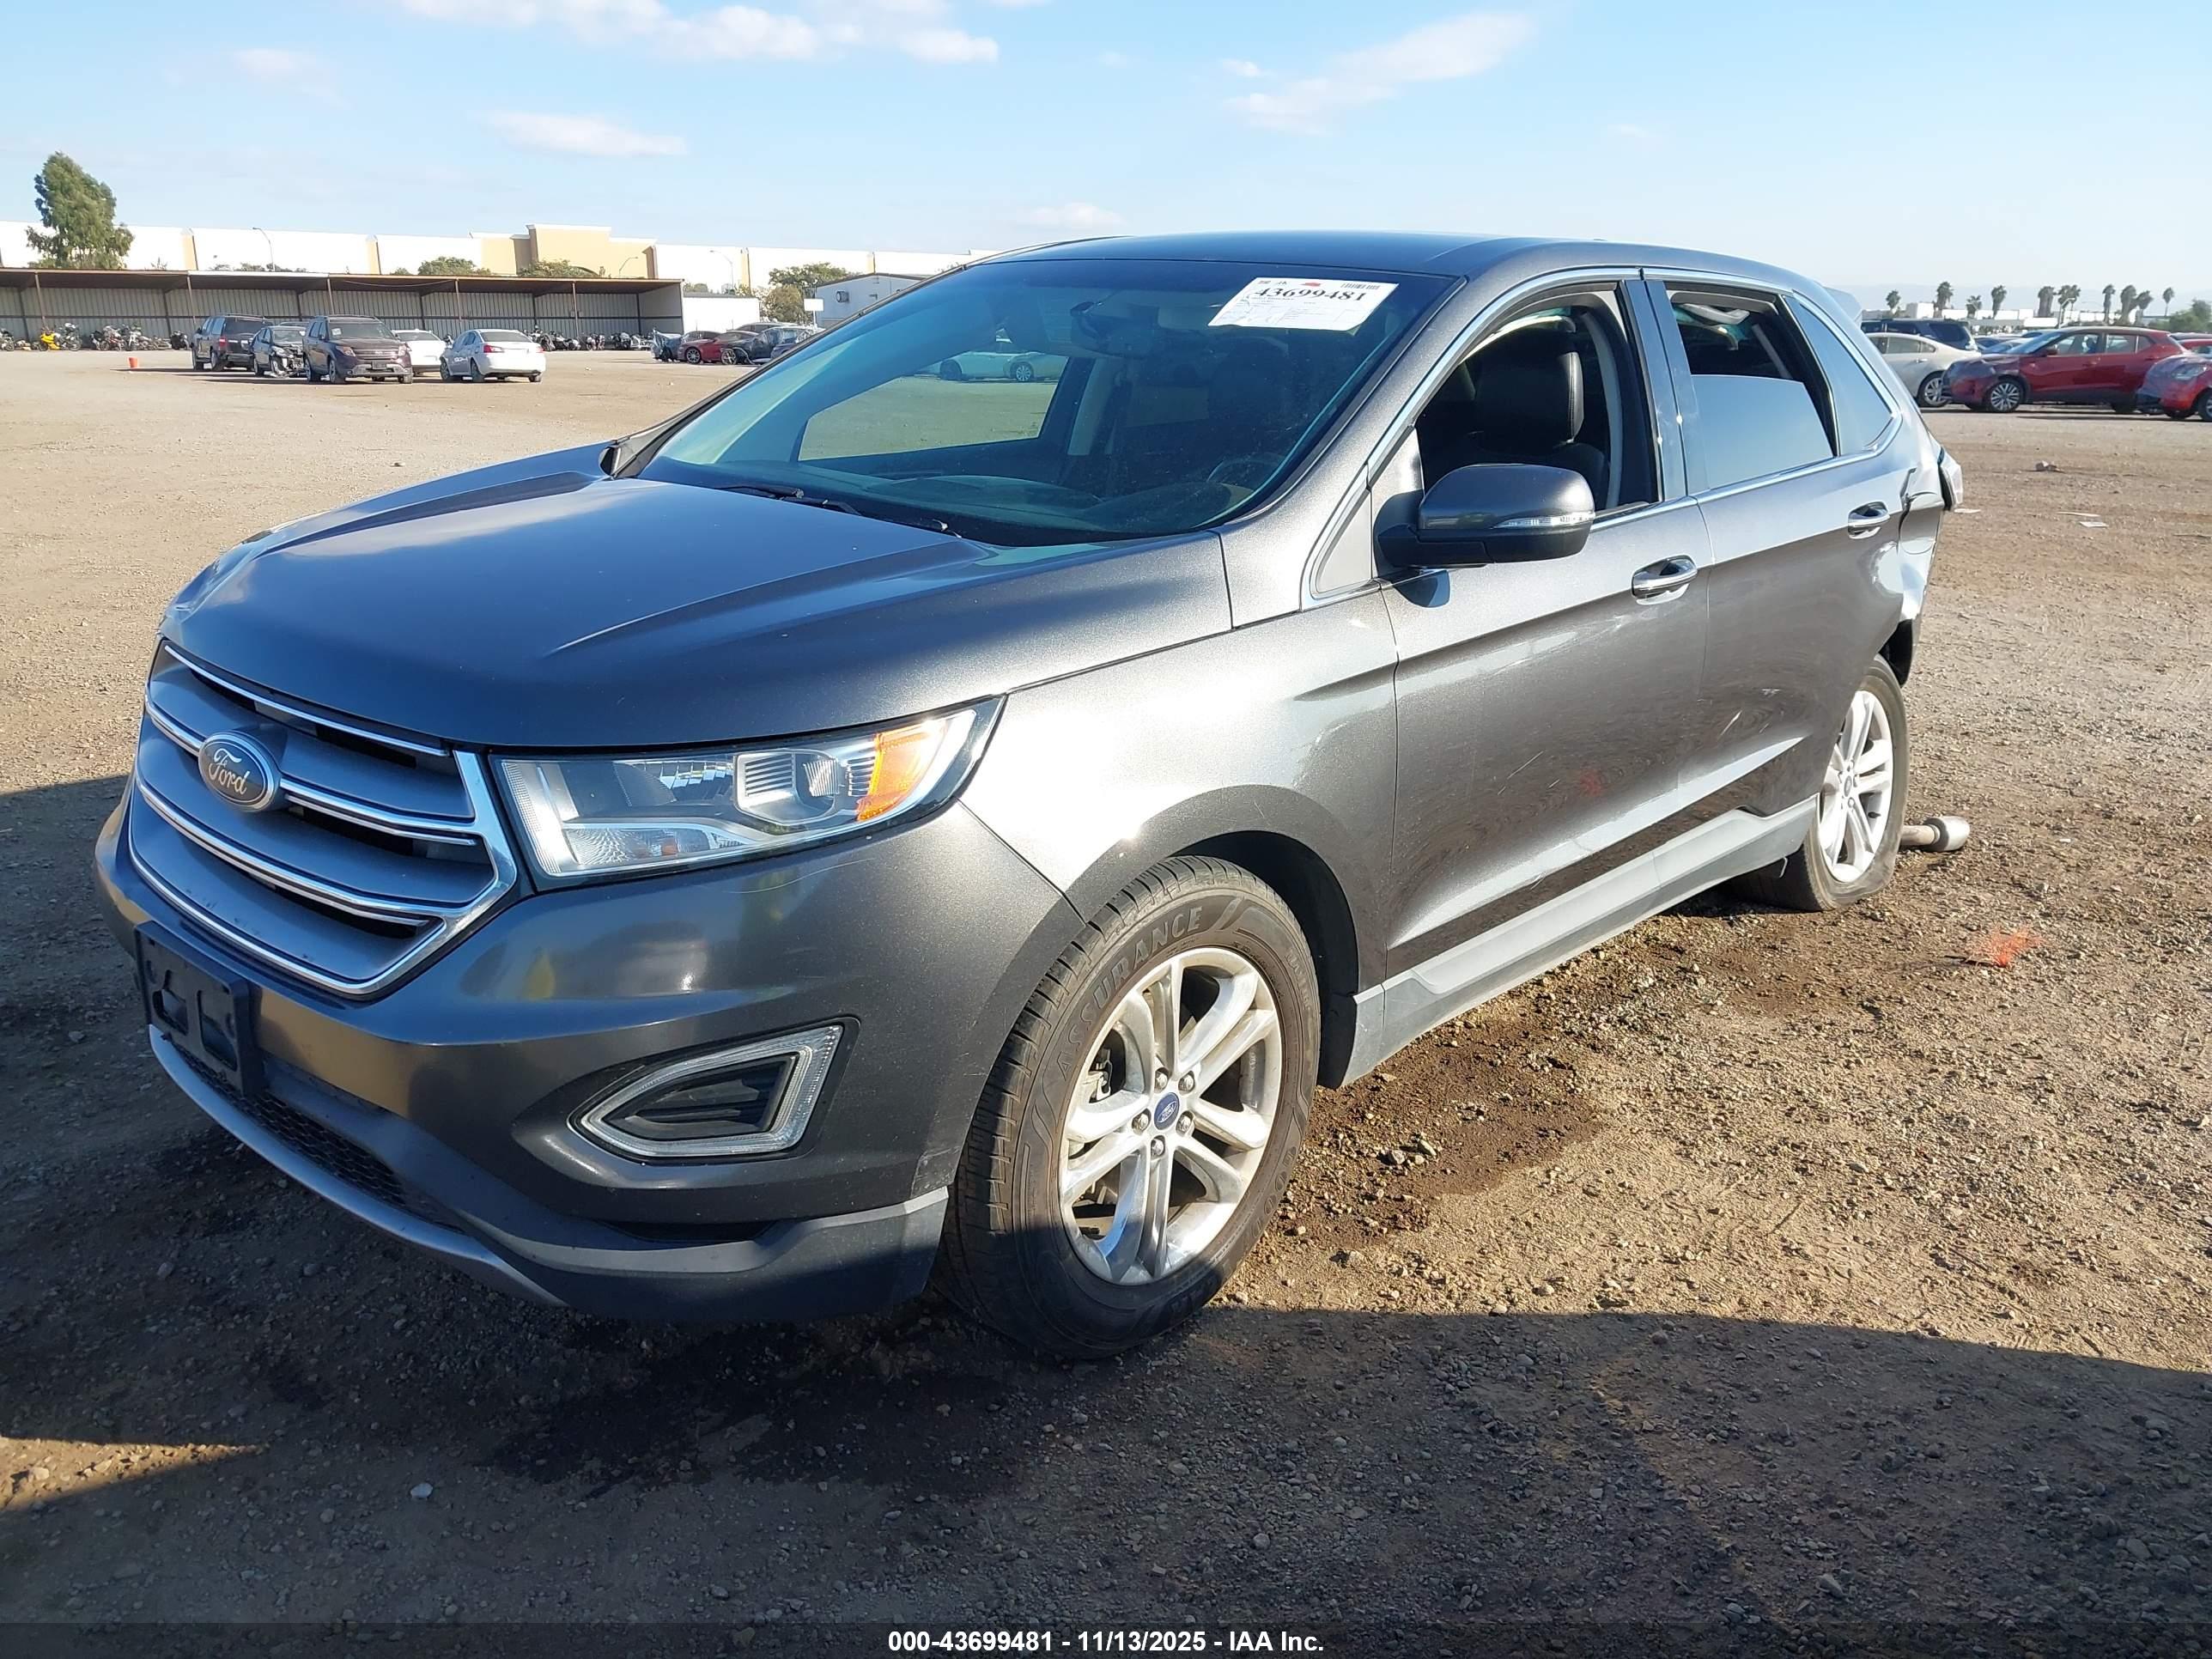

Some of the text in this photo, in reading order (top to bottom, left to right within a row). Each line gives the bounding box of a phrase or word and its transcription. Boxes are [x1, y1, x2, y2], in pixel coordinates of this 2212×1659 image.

[1254, 287, 1367, 301] 43699481
[208, 747, 251, 795] Ford
[1055, 906, 1204, 1082] ASSURANCE
